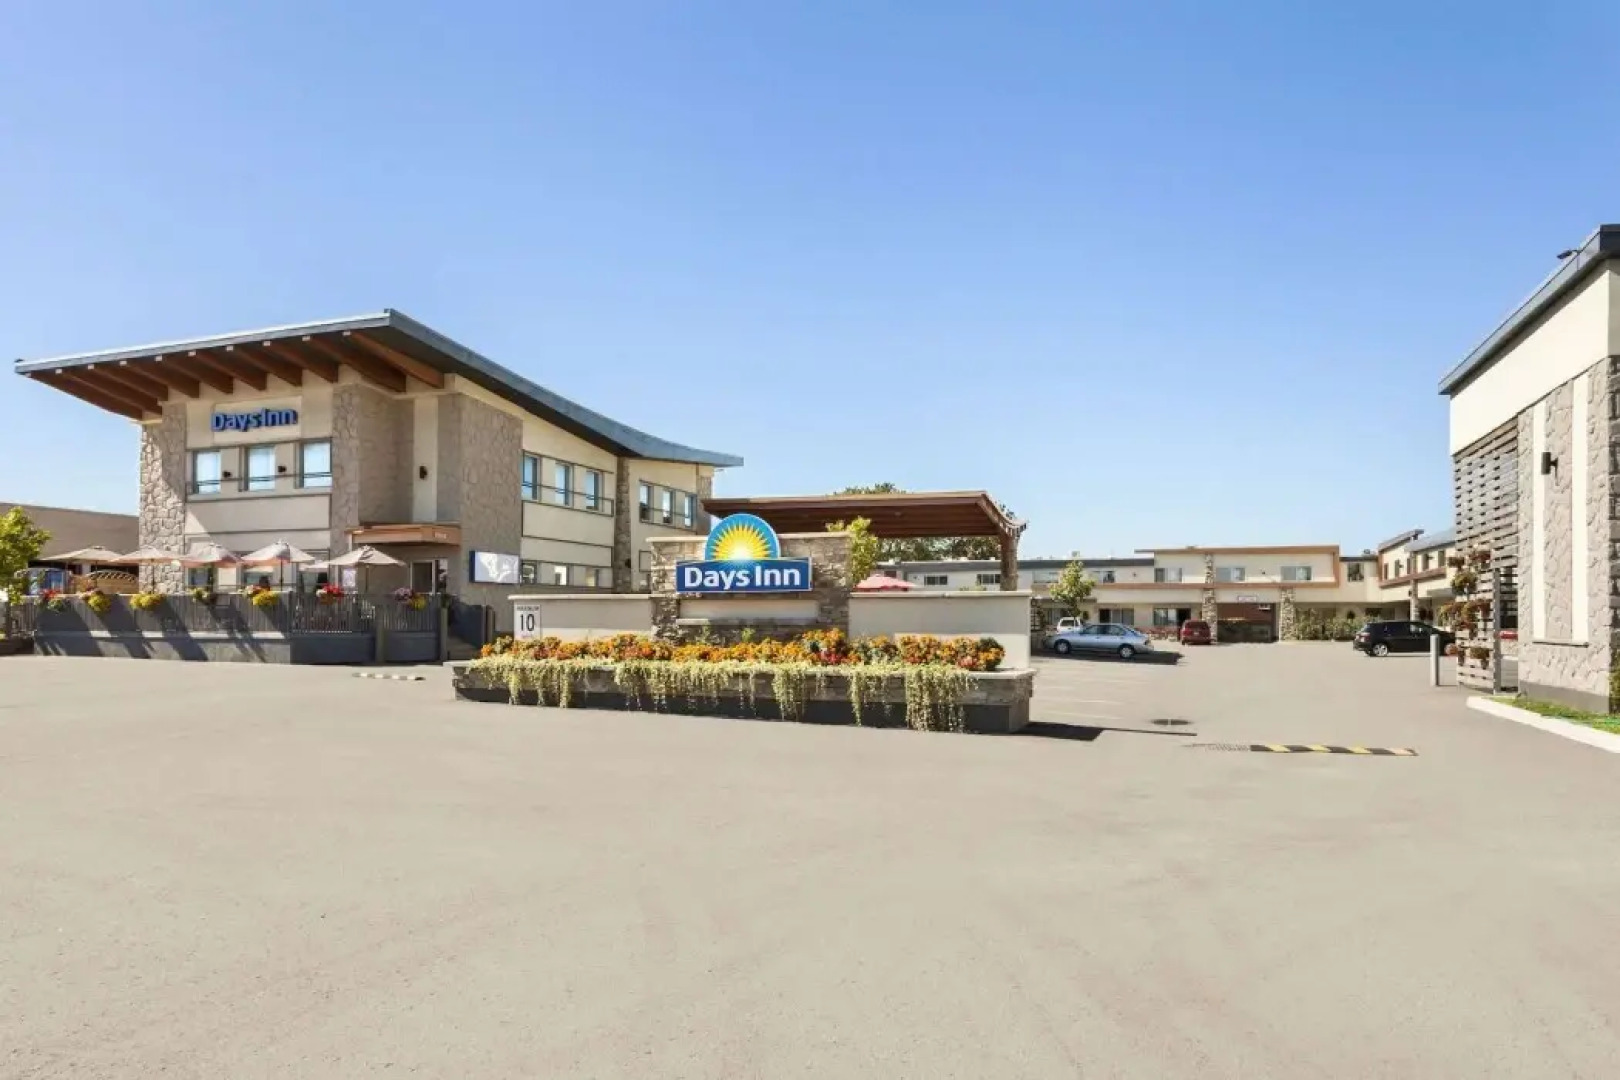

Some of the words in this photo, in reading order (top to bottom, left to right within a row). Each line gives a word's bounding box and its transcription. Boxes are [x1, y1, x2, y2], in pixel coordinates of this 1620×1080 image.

[210, 412, 260, 432] Days
[261, 408, 298, 426] Inn
[684, 567, 750, 590] Days
[755, 565, 800, 586] Inn
[520, 613, 535, 631] 10
